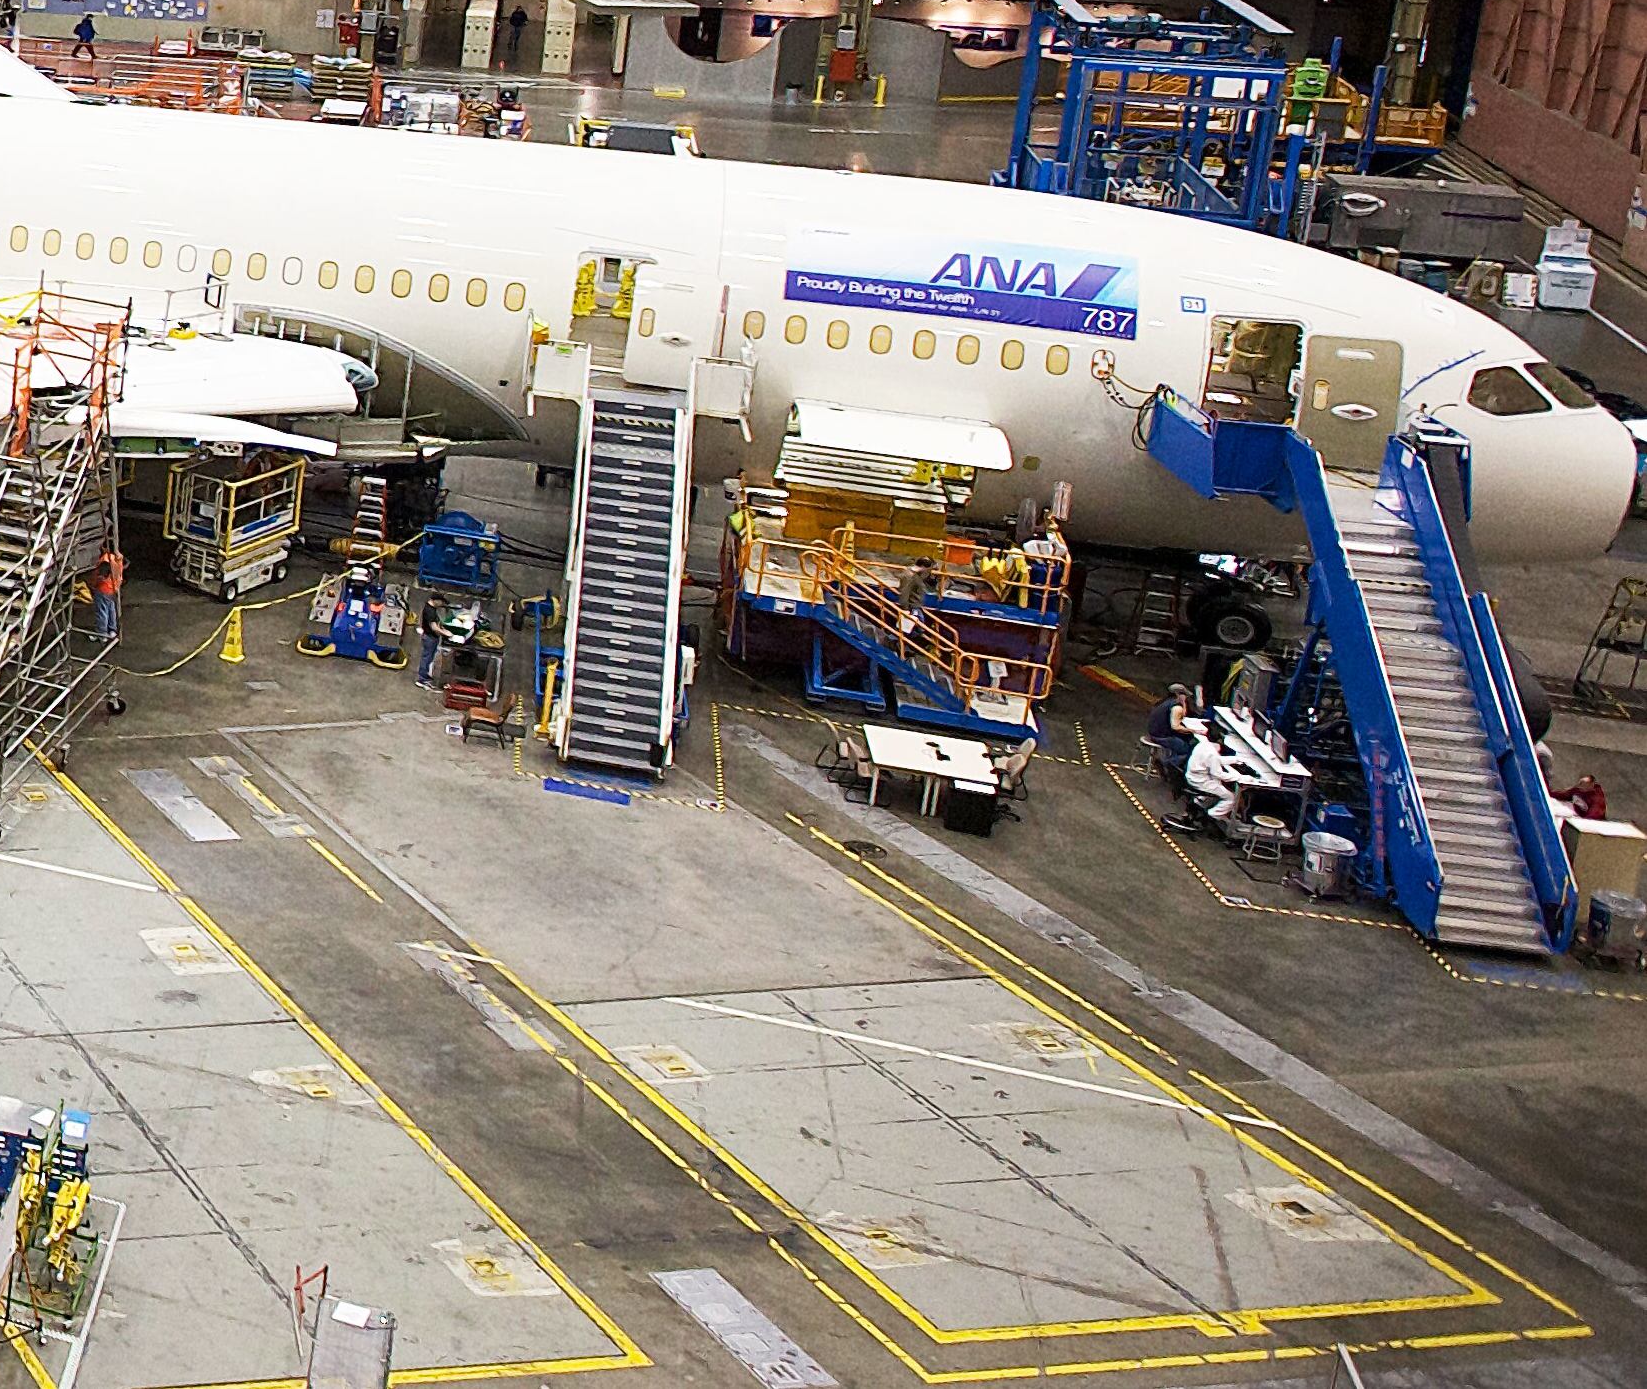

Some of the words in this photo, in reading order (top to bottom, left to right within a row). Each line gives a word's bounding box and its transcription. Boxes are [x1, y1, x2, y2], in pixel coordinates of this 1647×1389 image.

[929, 252, 1057, 297] ANA
[796, 275, 846, 294] Proudly
[848, 280, 901, 300] Building
[903, 287, 926, 300] the
[928, 289, 975, 305] Twelfth
[1081, 306, 1135, 333] 787
